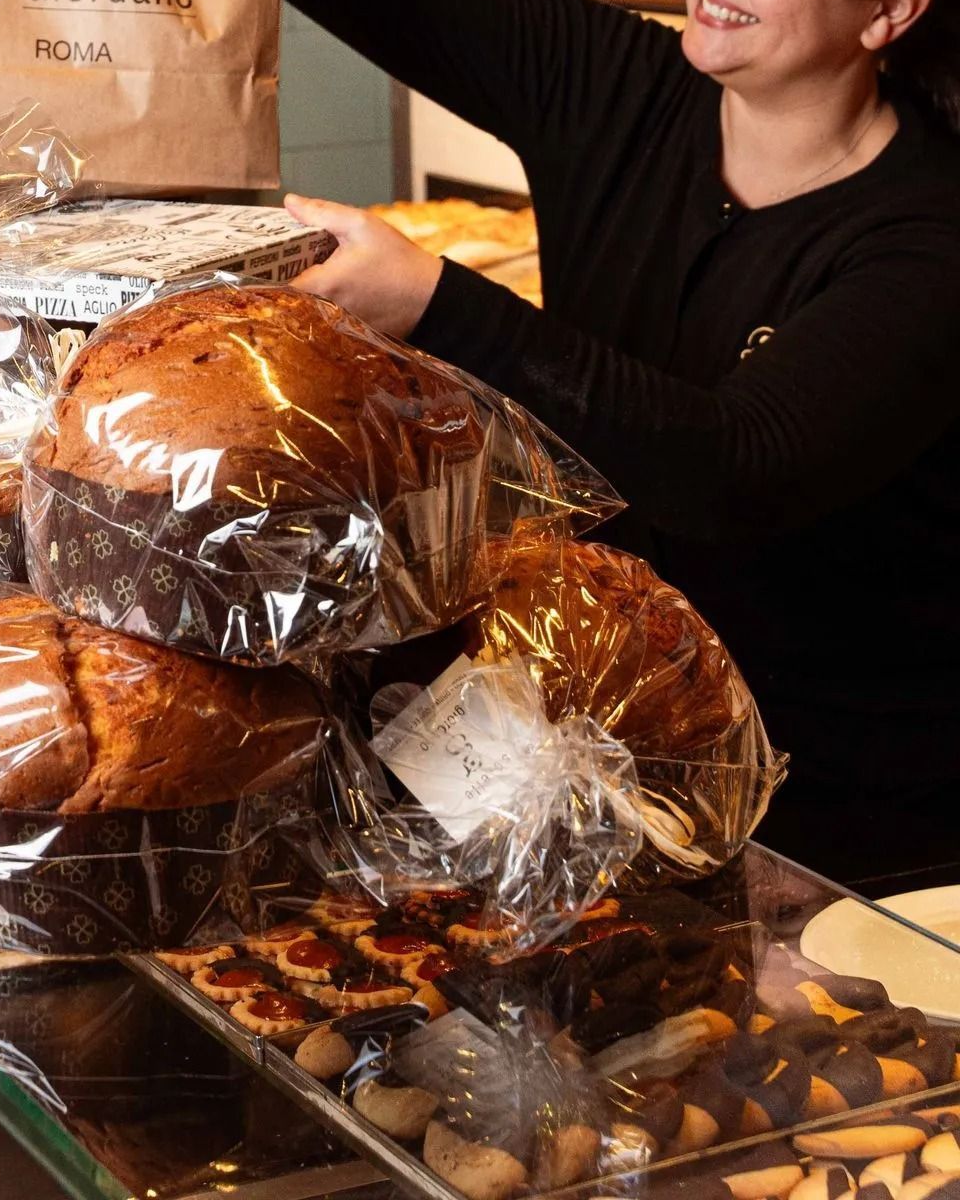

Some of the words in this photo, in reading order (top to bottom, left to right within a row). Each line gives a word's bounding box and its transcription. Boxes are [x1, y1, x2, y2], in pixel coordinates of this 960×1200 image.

[35, 38, 113, 63] ROMA
[75, 282, 108, 297] speck
[34, 296, 77, 317] PIZZA
[84, 299, 118, 315] AGLIO
